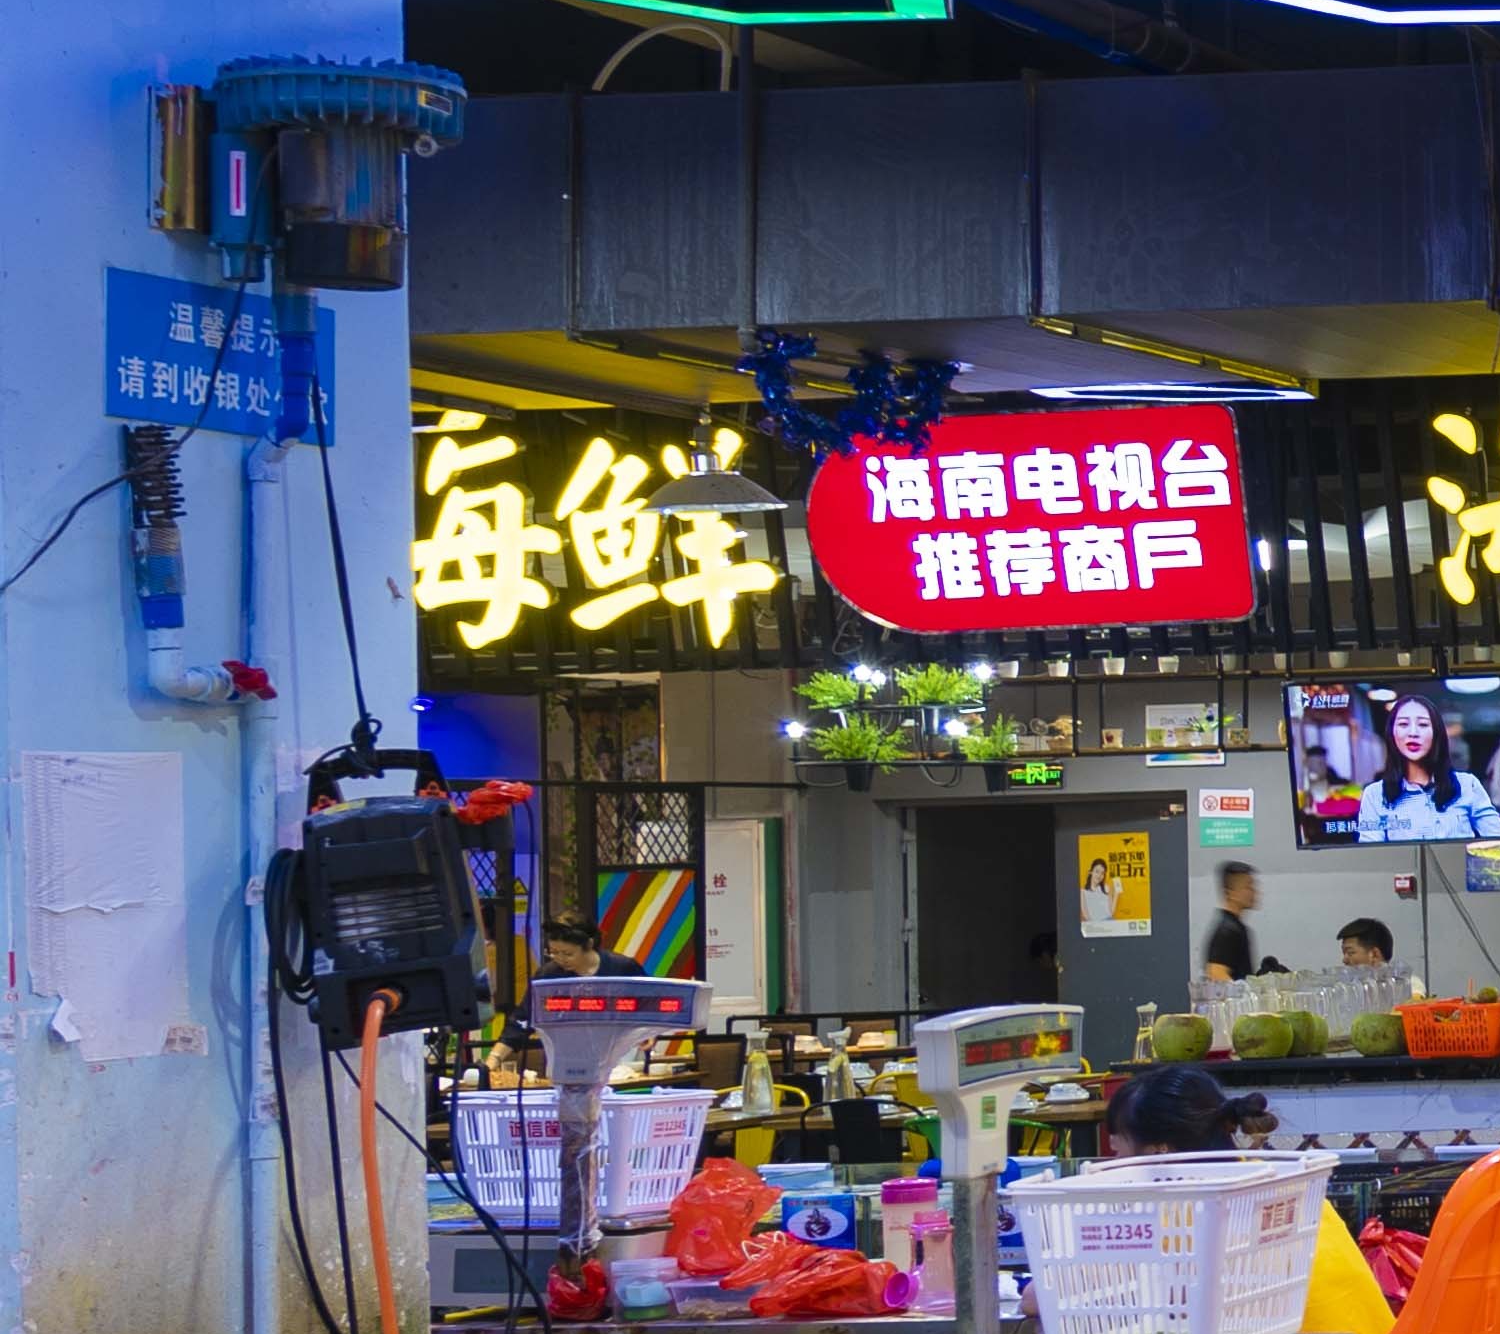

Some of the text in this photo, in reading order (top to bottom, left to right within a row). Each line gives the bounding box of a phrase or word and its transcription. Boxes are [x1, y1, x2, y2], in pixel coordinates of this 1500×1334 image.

[168, 302, 284, 357] 温馨提示
[118, 355, 329, 425] 请到收银处
[865, 439, 1232, 523] 海南电视台
[1104, 1224, 1153, 1240] 12345
